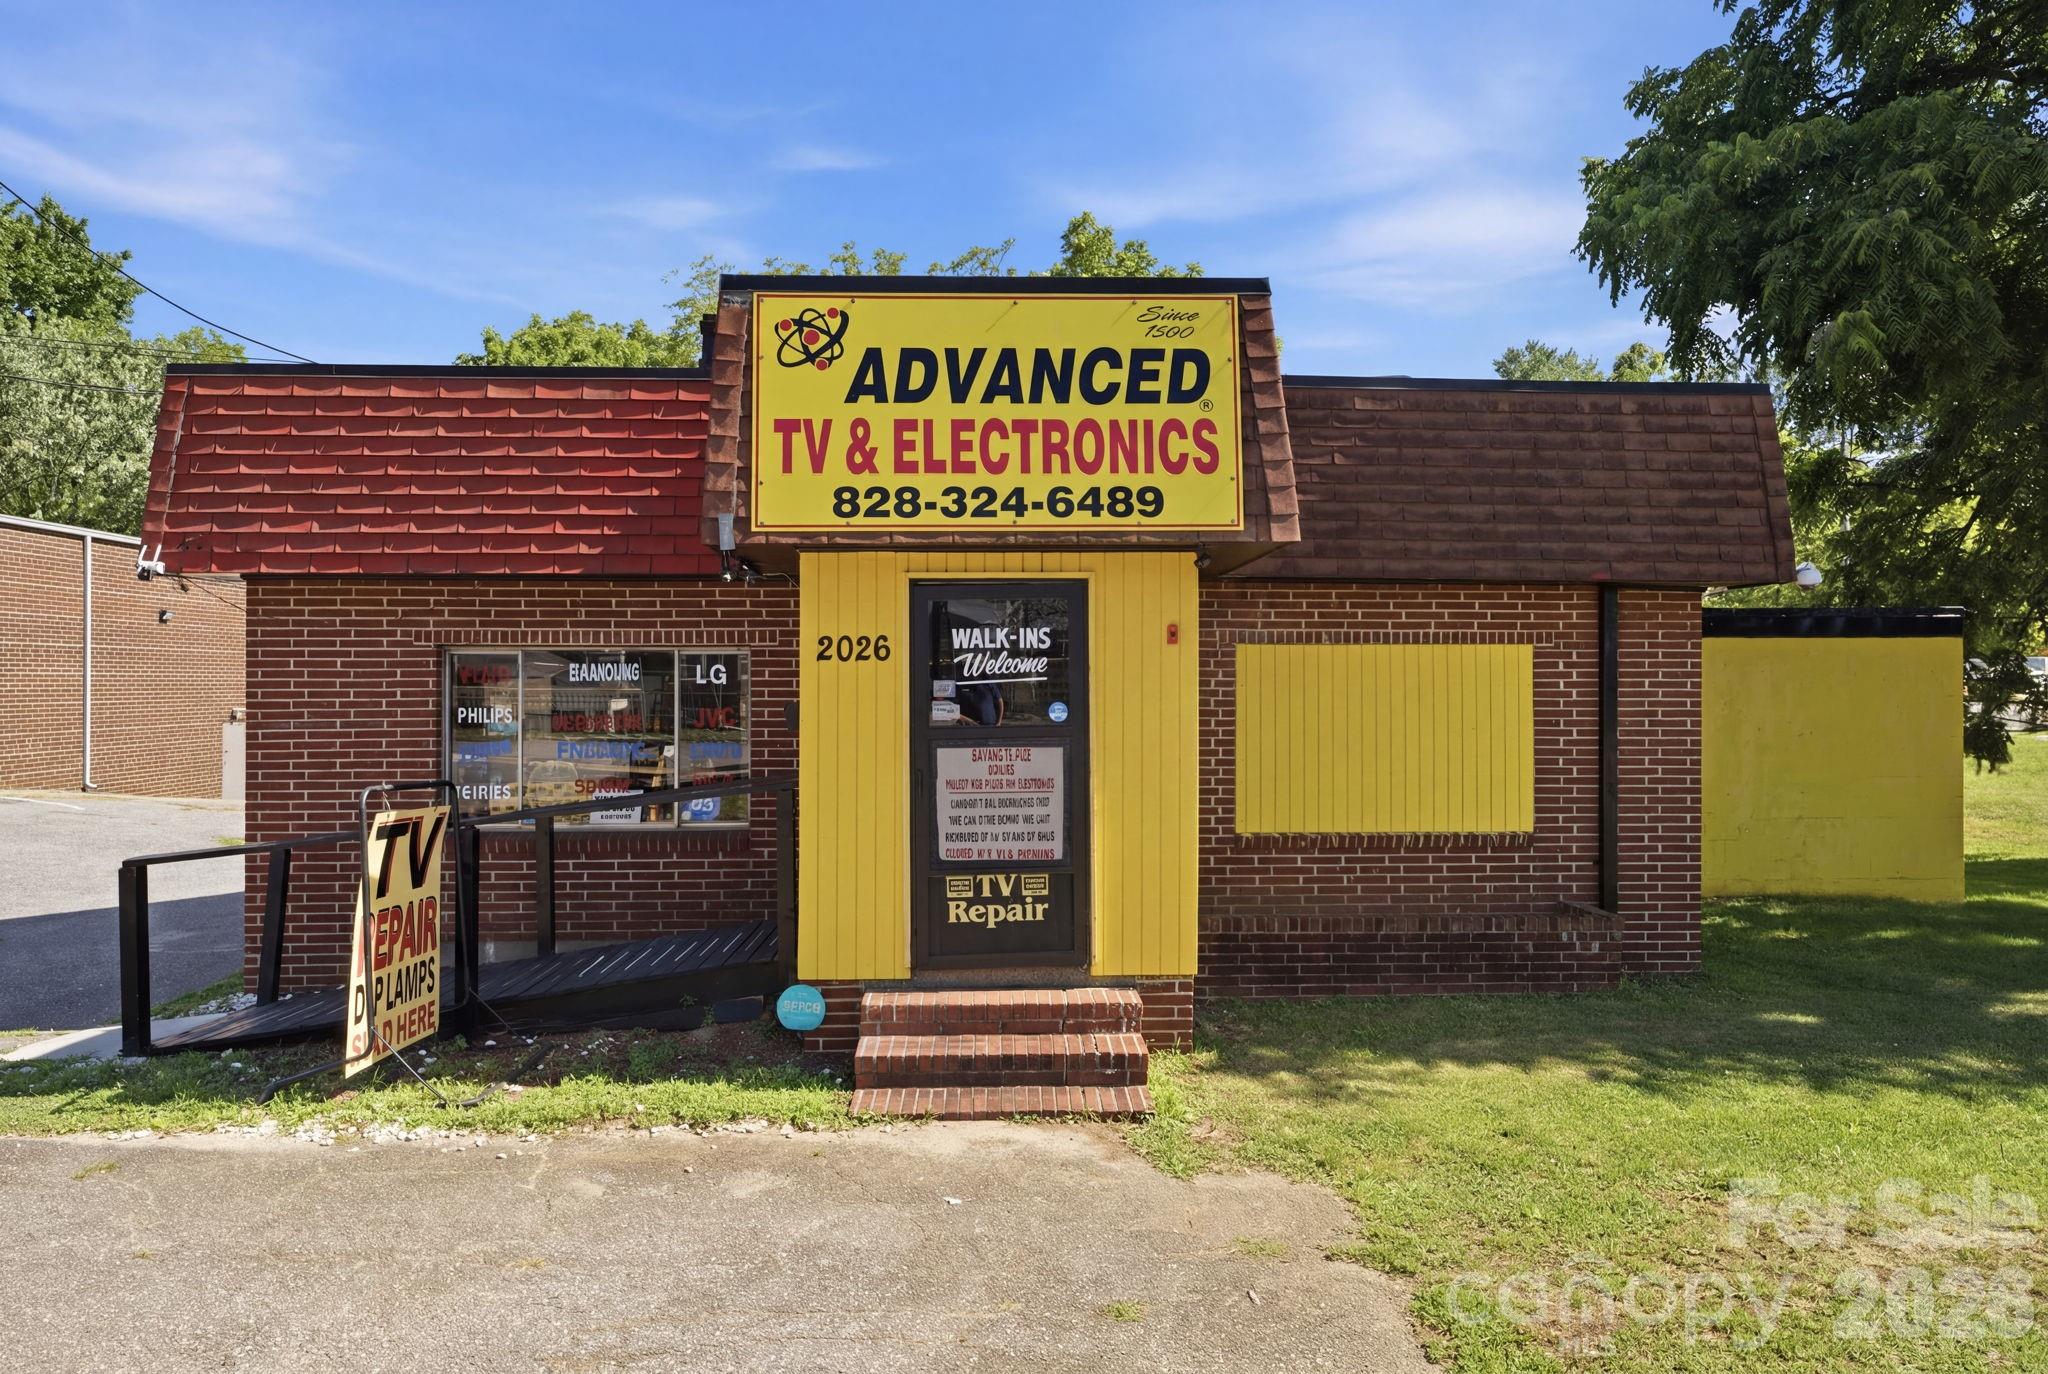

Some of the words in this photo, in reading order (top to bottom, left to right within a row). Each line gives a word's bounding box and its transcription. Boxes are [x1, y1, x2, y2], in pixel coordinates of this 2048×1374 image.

[1136, 305, 1200, 323] Since
[843, 346, 1211, 404] ADVANCED
[773, 418, 833, 475] TV
[845, 416, 879, 475] &
[893, 416, 1221, 476] ELECTRONICS
[832, 485, 1166, 519] 828-324-6489
[816, 634, 891, 662] 2026
[951, 626, 1051, 650] WALK-INS
[696, 664, 727, 685] LG
[953, 650, 1048, 677] Welcome
[457, 705, 513, 724] PHILIPS
[693, 706, 737, 729] JVC
[376, 811, 447, 899] TV
[976, 874, 1018, 898] TV
[947, 896, 1049, 929] Repair
[354, 976, 384, 1026] DP
[386, 955, 436, 1012] LAMPS
[396, 999, 437, 1045] HERE
